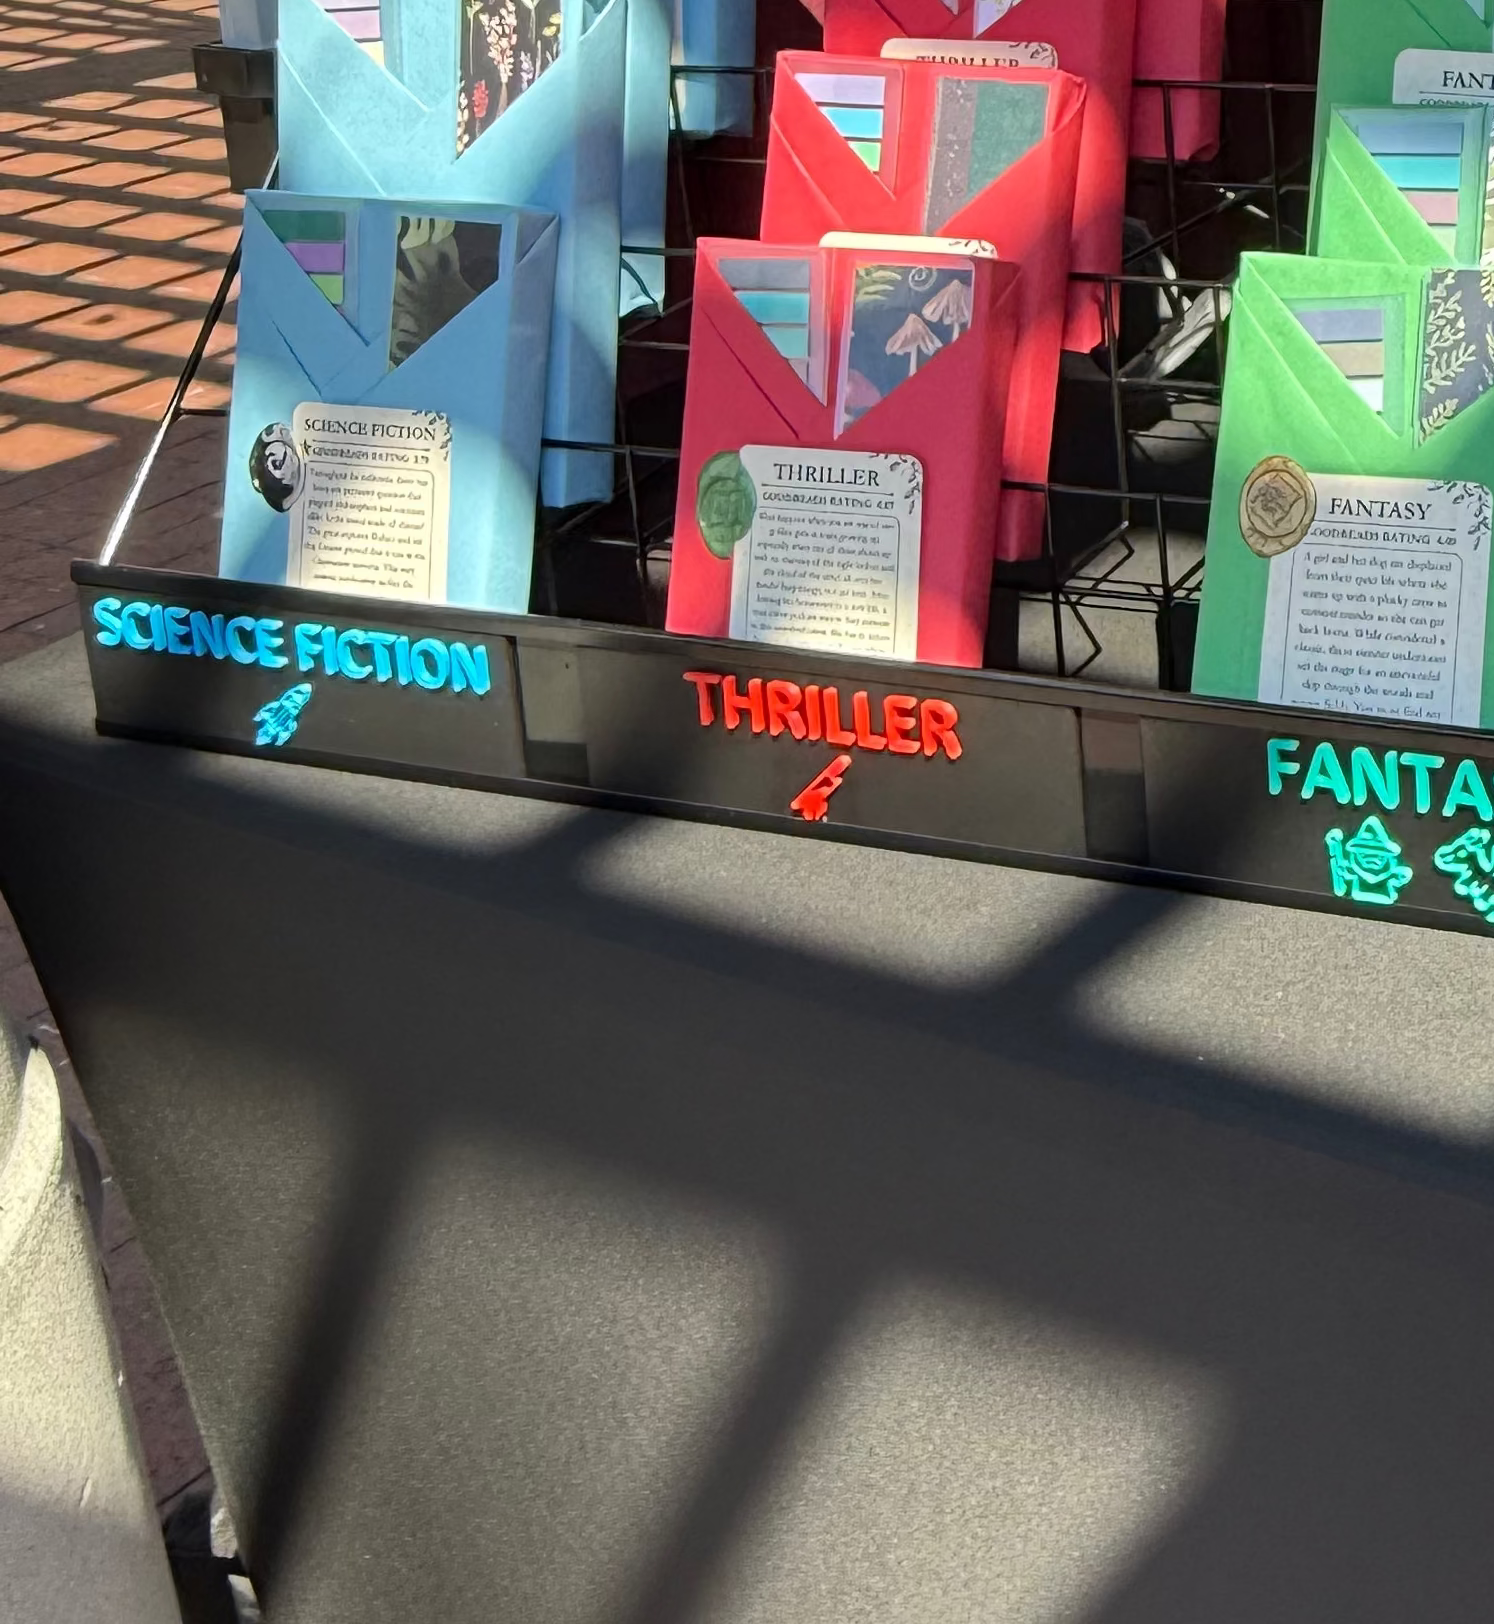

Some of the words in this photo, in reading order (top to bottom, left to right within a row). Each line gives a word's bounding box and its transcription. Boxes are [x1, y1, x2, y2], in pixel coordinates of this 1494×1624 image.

[304, 418, 368, 436] SCIENCE
[371, 423, 436, 441] FICTION
[773, 462, 881, 487] THRILLER
[1328, 497, 1433, 521] FANTASY
[92, 597, 290, 670] SCIENCE
[293, 622, 492, 697] FICTION
[682, 671, 964, 761] THRILLER
